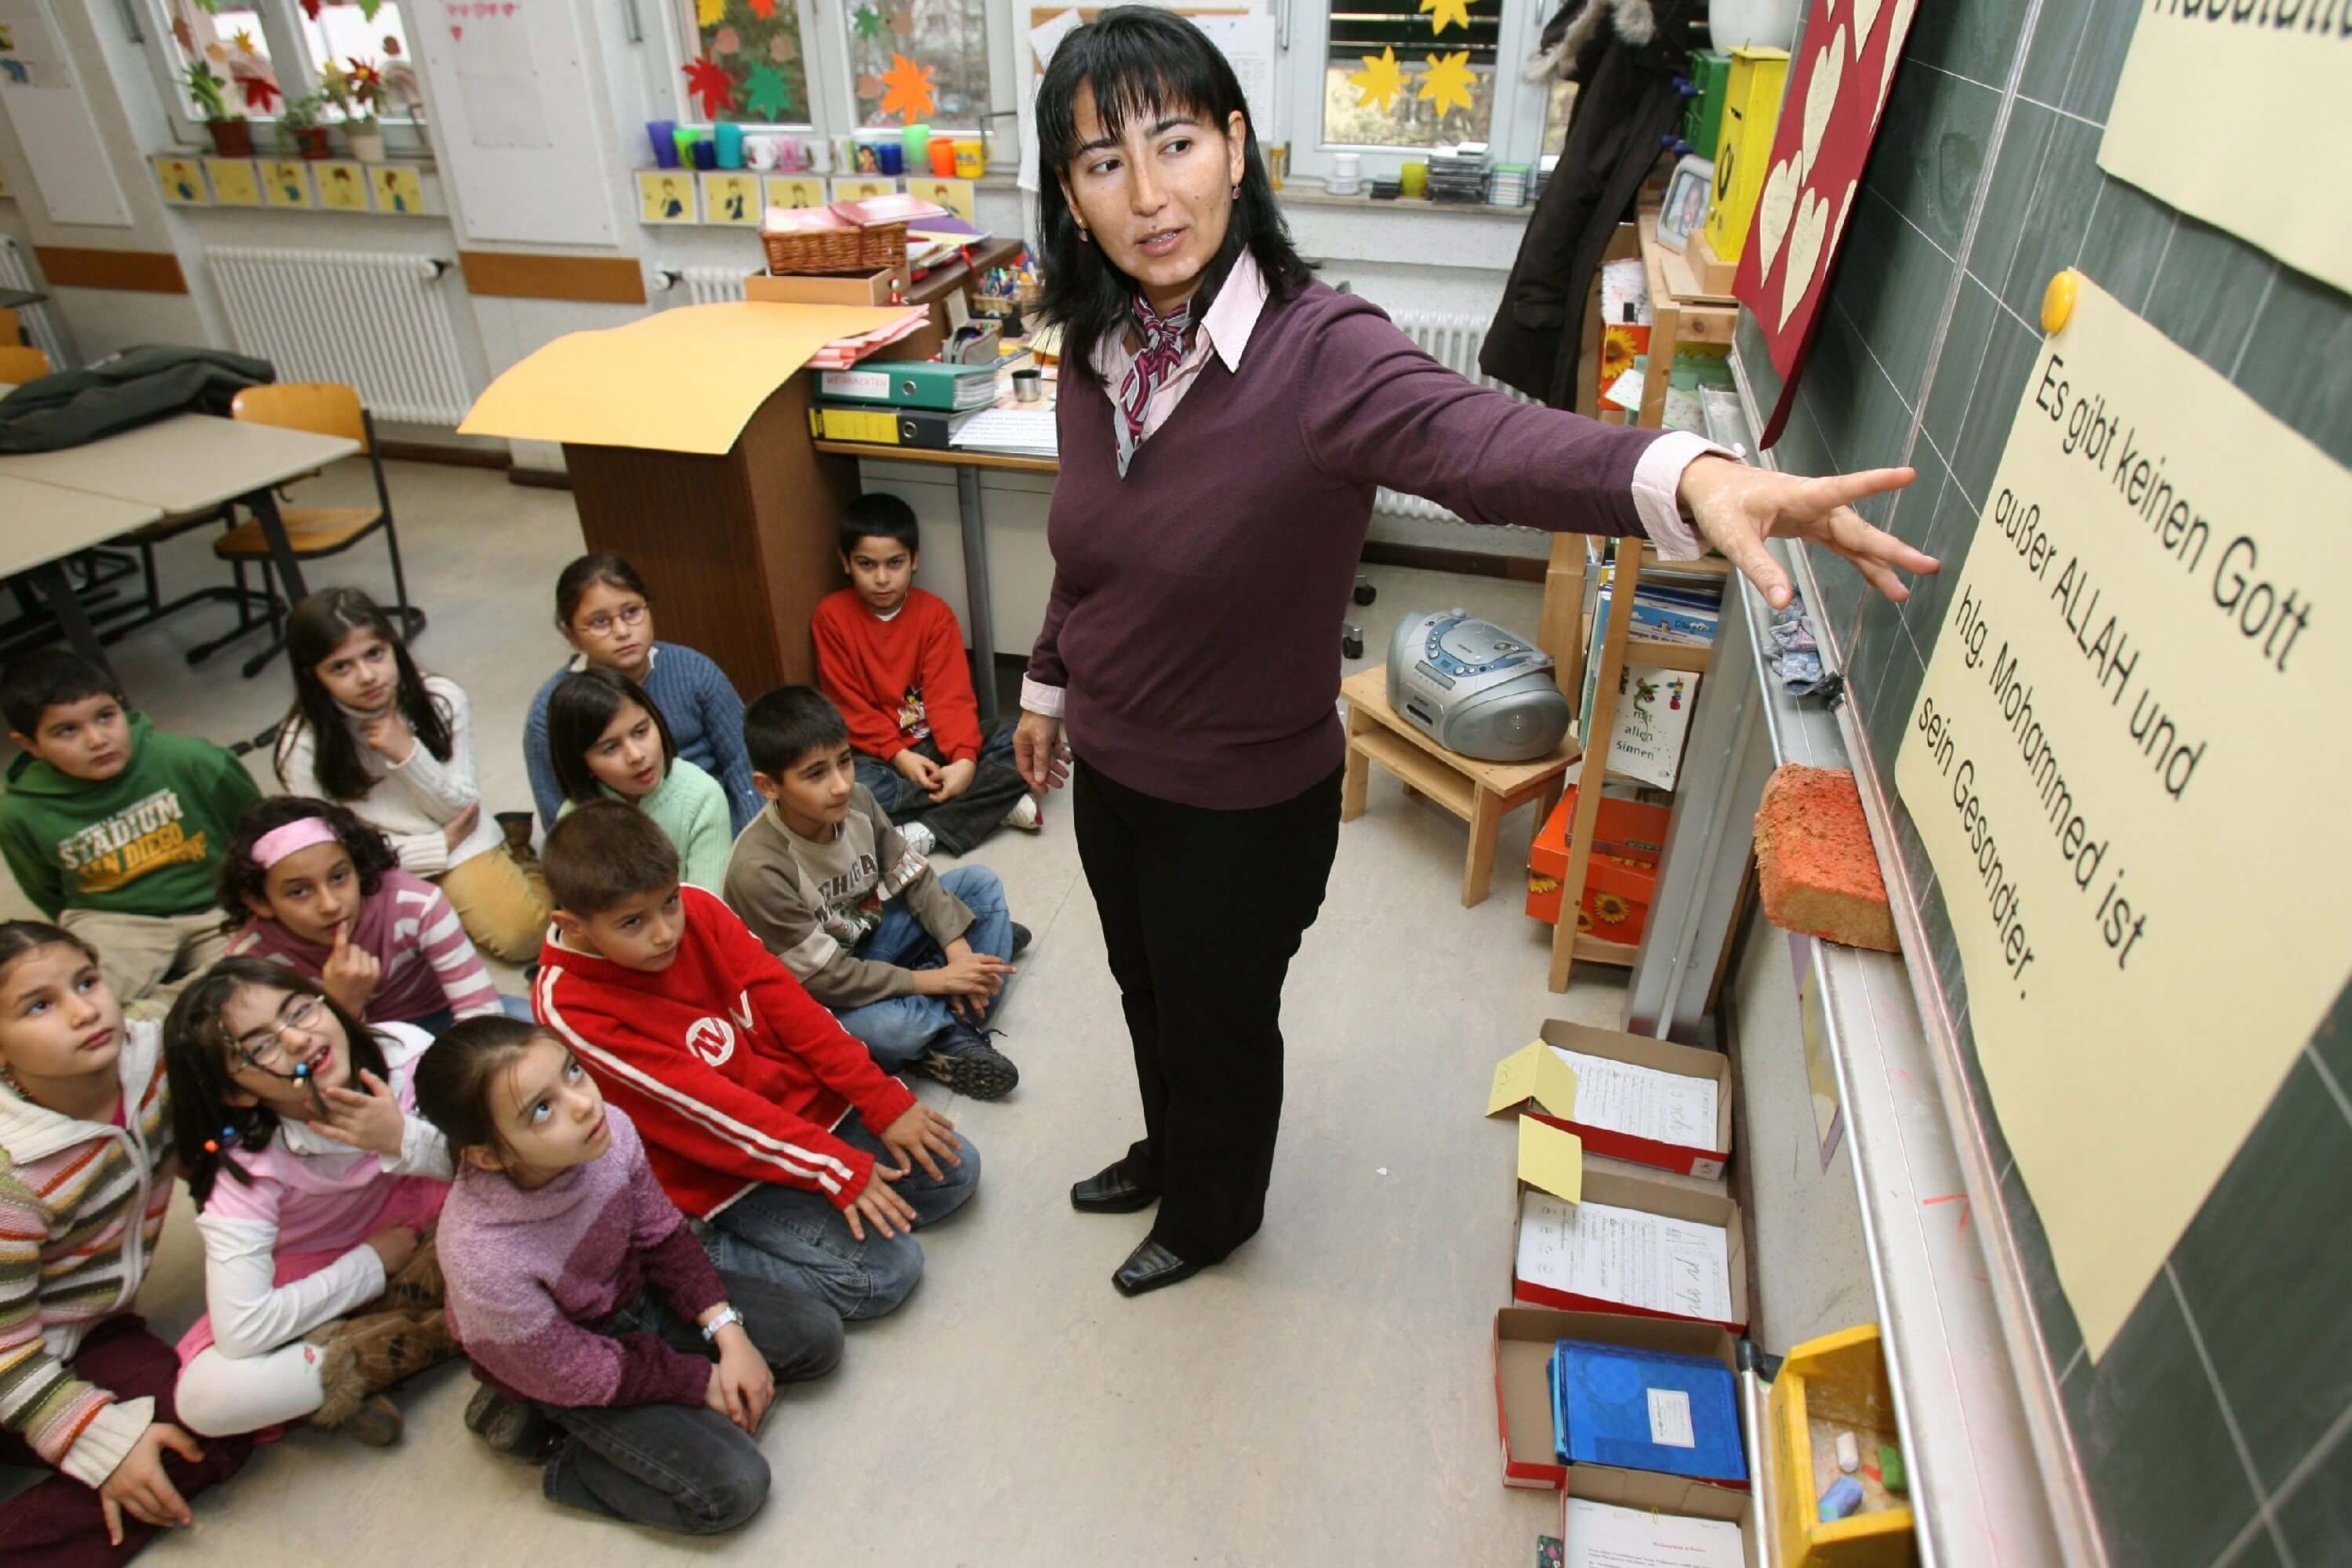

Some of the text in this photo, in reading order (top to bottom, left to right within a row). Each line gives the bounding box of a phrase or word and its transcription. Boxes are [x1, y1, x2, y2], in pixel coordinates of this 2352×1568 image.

[1994, 488, 2208, 803] außer ALLAH und
[2035, 354, 2313, 673] Es gibt keinen Gott
[59, 792, 184, 870] STADIUM
[122, 821, 184, 869] DIEGO
[1918, 696, 2034, 1000] sein Gesandter.
[1955, 583, 2147, 971] hlg. Mohammed ist
